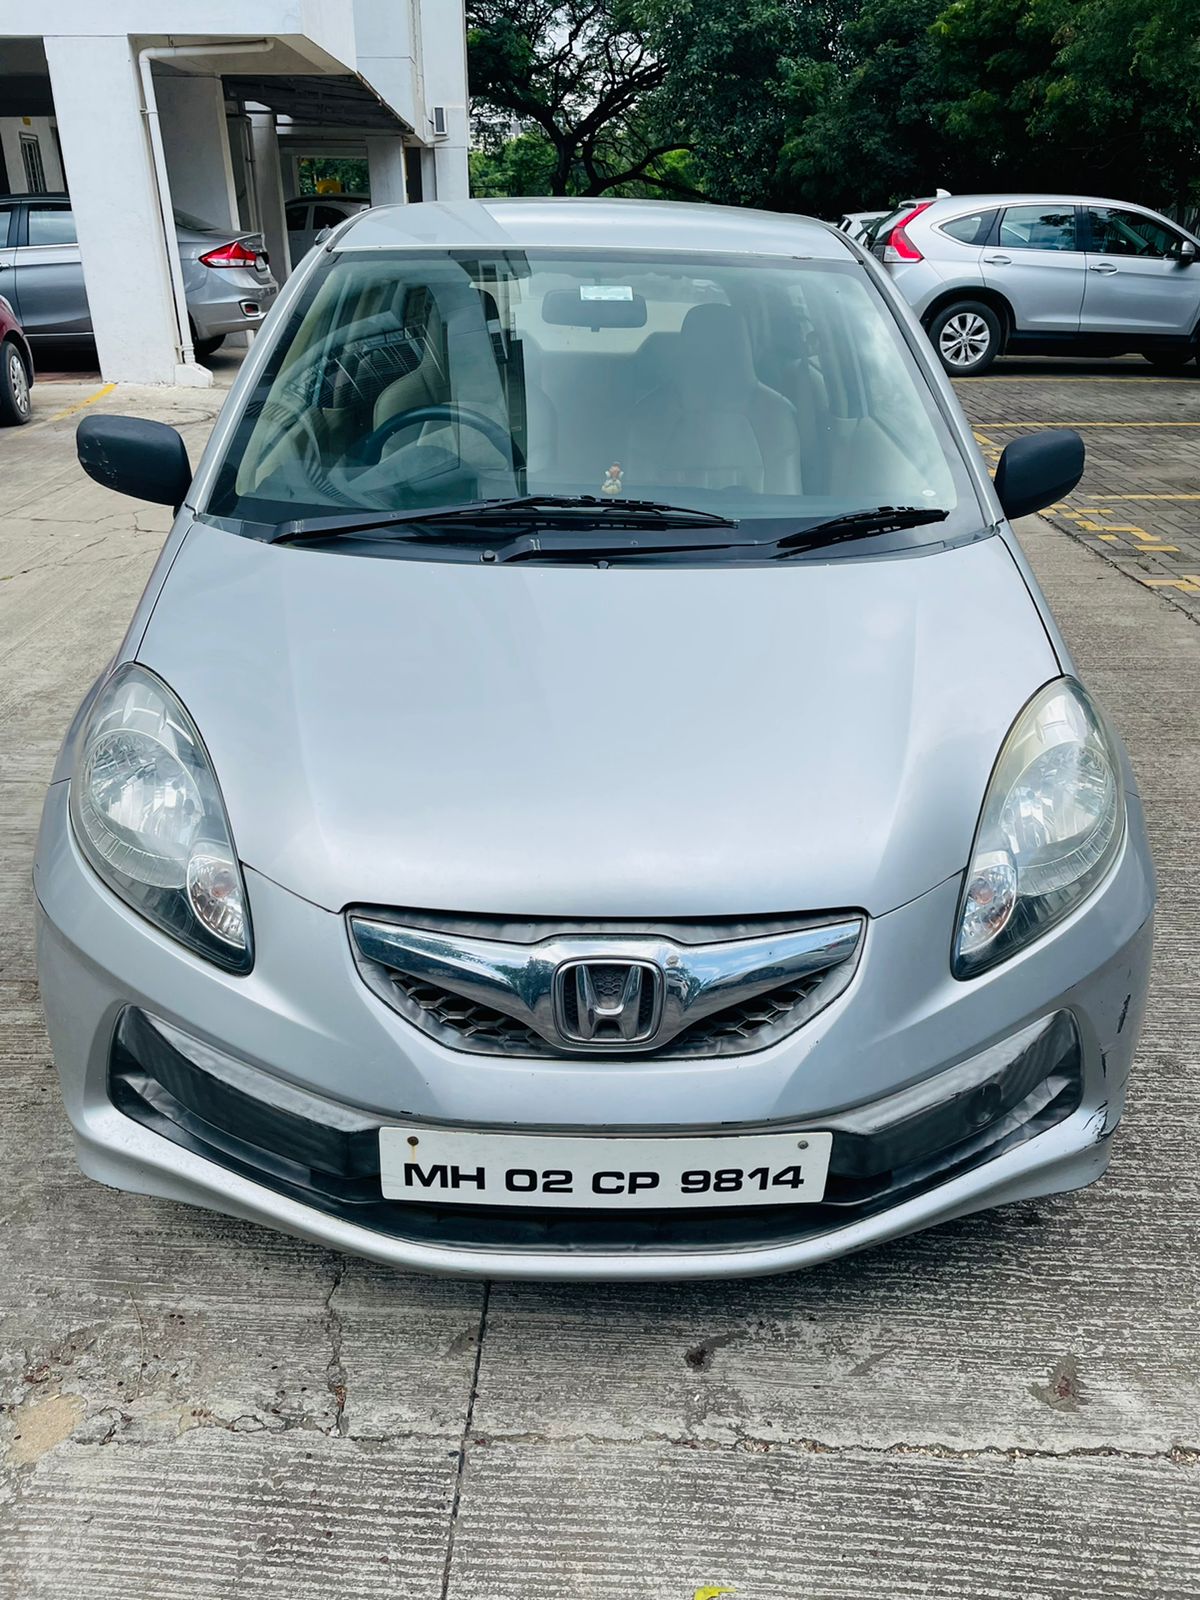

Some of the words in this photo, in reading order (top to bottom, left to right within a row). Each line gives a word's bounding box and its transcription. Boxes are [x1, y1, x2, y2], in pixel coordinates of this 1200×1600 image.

[404, 1163, 485, 1190] MH
[505, 1169, 573, 1193] 02
[592, 1172, 660, 1194] CP
[681, 1166, 804, 1193] 9814
